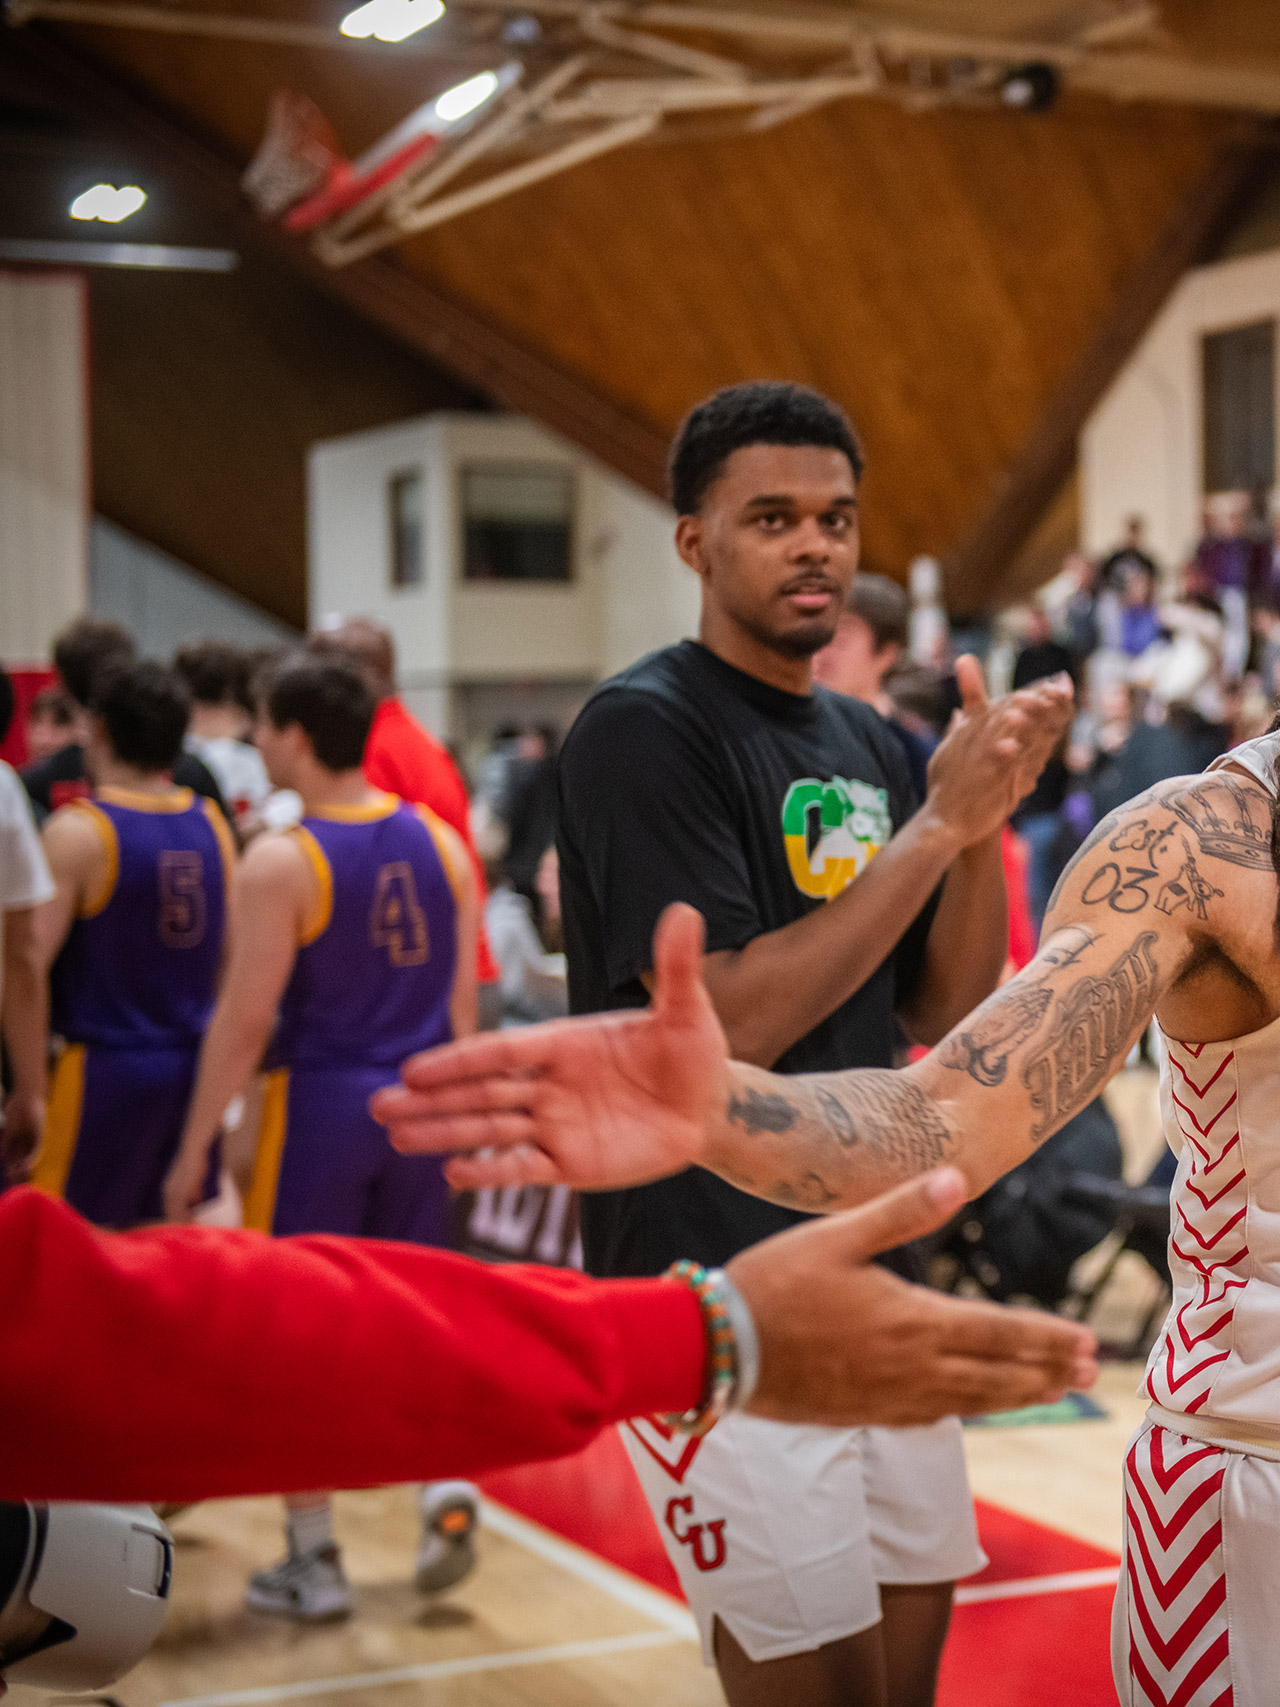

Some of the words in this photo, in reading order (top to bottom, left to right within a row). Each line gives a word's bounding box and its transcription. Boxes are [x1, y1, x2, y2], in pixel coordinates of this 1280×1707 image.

[157, 849, 206, 949] 5
[368, 861, 430, 967] 4
[665, 1495, 726, 1573] CU
